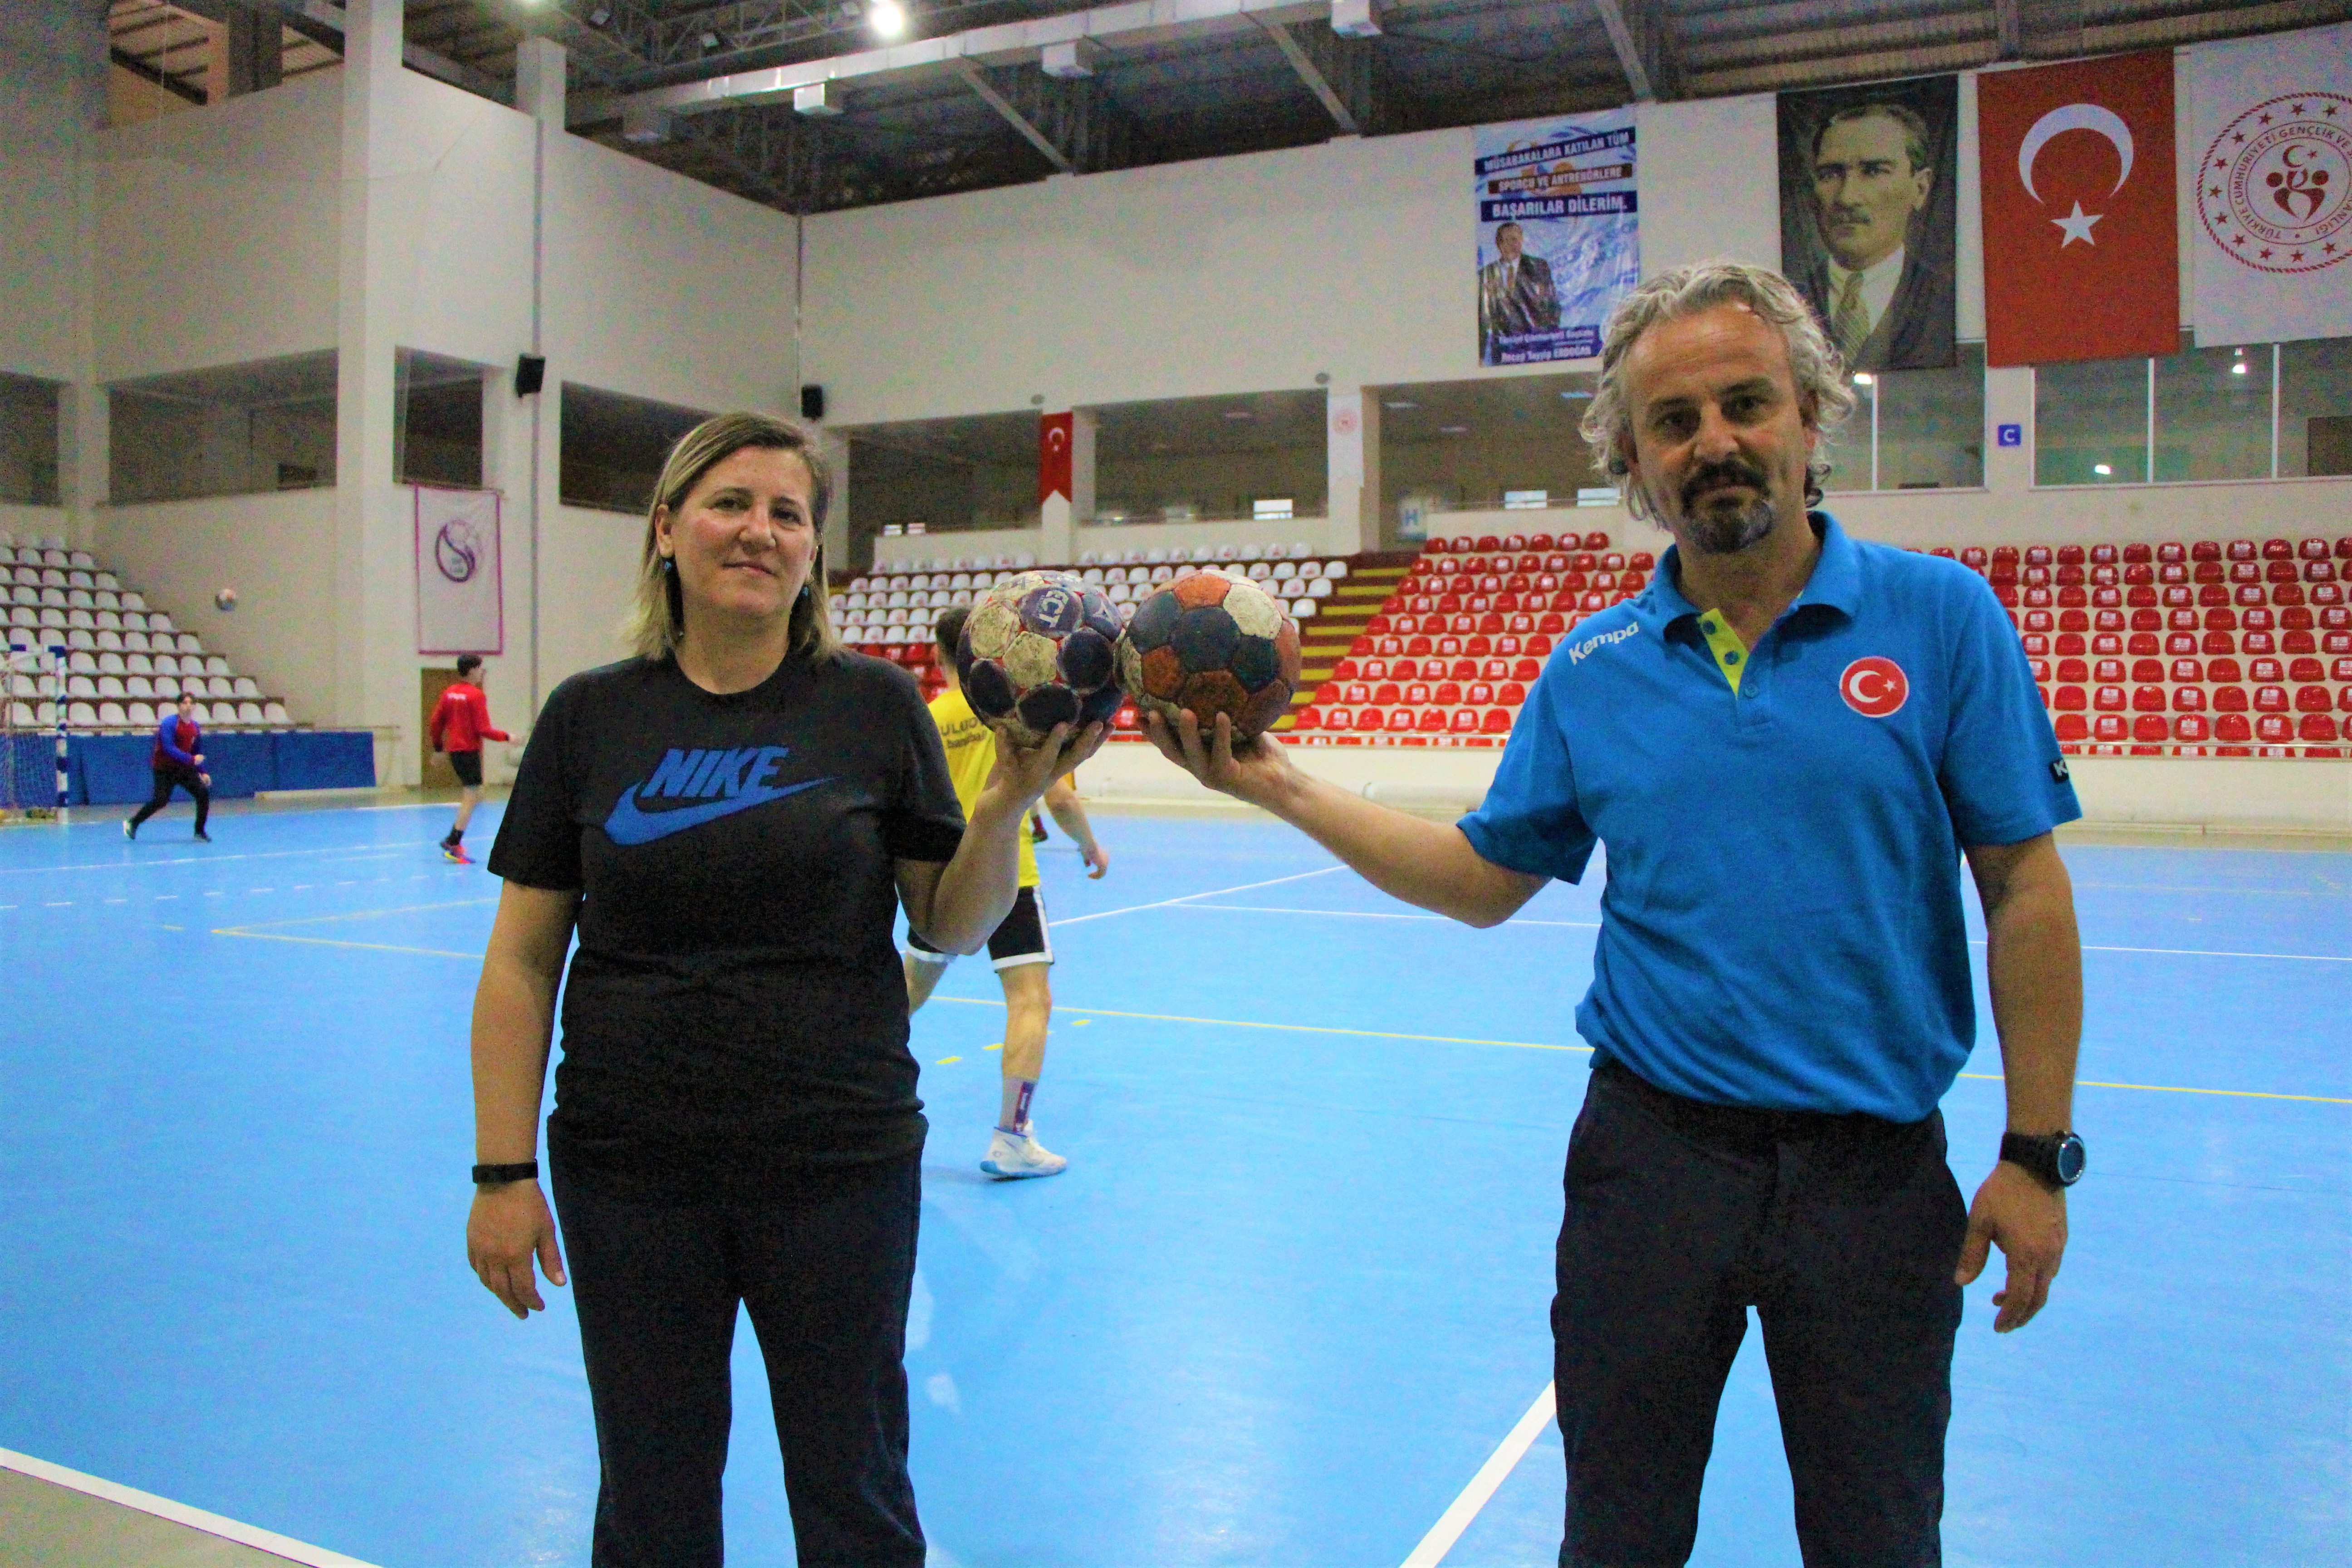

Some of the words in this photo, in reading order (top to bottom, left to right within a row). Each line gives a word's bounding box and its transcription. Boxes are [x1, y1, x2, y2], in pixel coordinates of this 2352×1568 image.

[1565, 137, 1605, 155] KATILAN
[1492, 199, 1564, 220] BAŞARILAR
[2004, 428, 2014, 442] C
[1568, 621, 1640, 666] Kempa
[640, 745, 789, 798] NIKE
